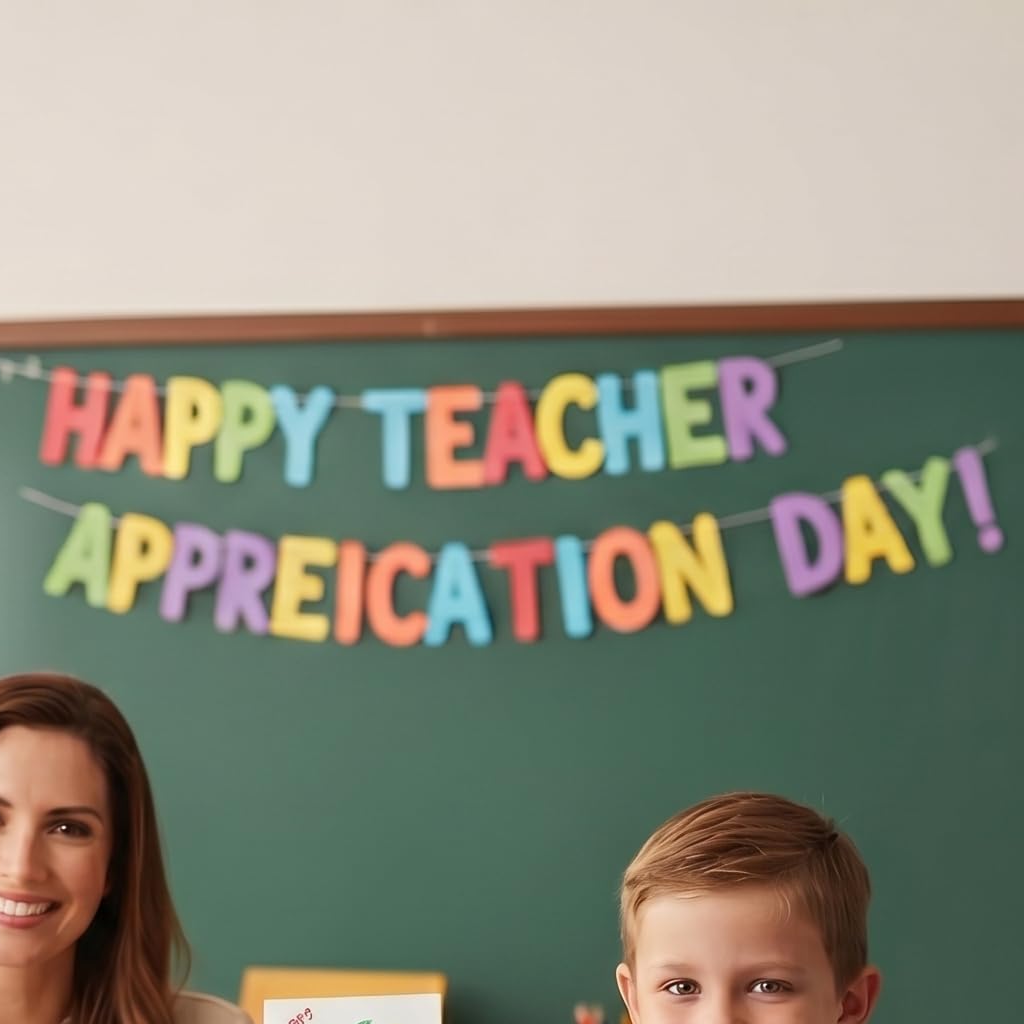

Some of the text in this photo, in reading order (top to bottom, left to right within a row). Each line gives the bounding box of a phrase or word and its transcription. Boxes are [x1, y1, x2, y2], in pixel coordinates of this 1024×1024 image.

[38, 356, 787, 490] HAPPY TEACHER
[43, 446, 1003, 647] APPREICATION DAY!
